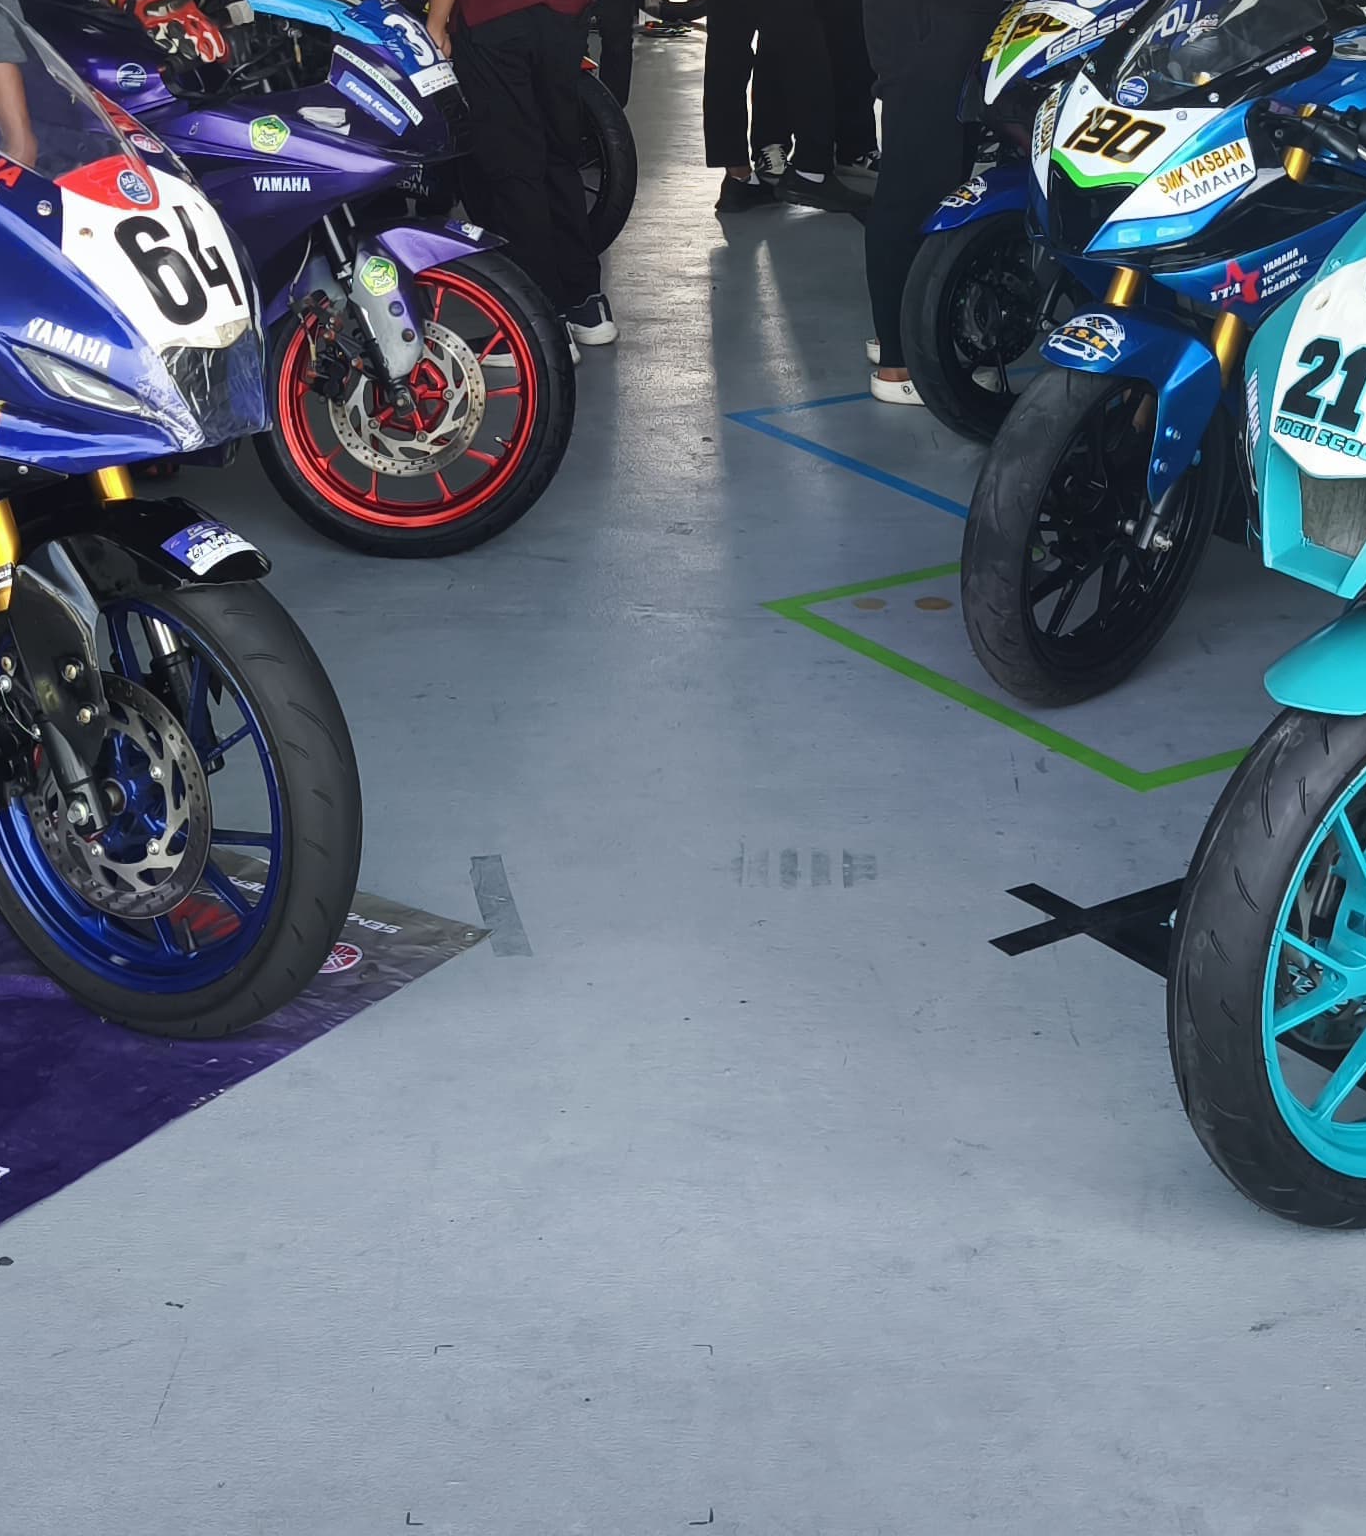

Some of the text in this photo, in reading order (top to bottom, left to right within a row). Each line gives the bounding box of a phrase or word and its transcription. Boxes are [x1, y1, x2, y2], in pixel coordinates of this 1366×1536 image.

[1062, 106, 1166, 164] 190
[253, 175, 312, 193] YAMAHA
[1155, 142, 1247, 195] SMK YASBAM
[1170, 162, 1254, 208] YAMAHA
[115, 205, 243, 326] 64
[1262, 247, 1299, 273] YAMAHA
[28, 317, 112, 369] YAMAHA
[1062, 326, 1109, 350] T.S.M
